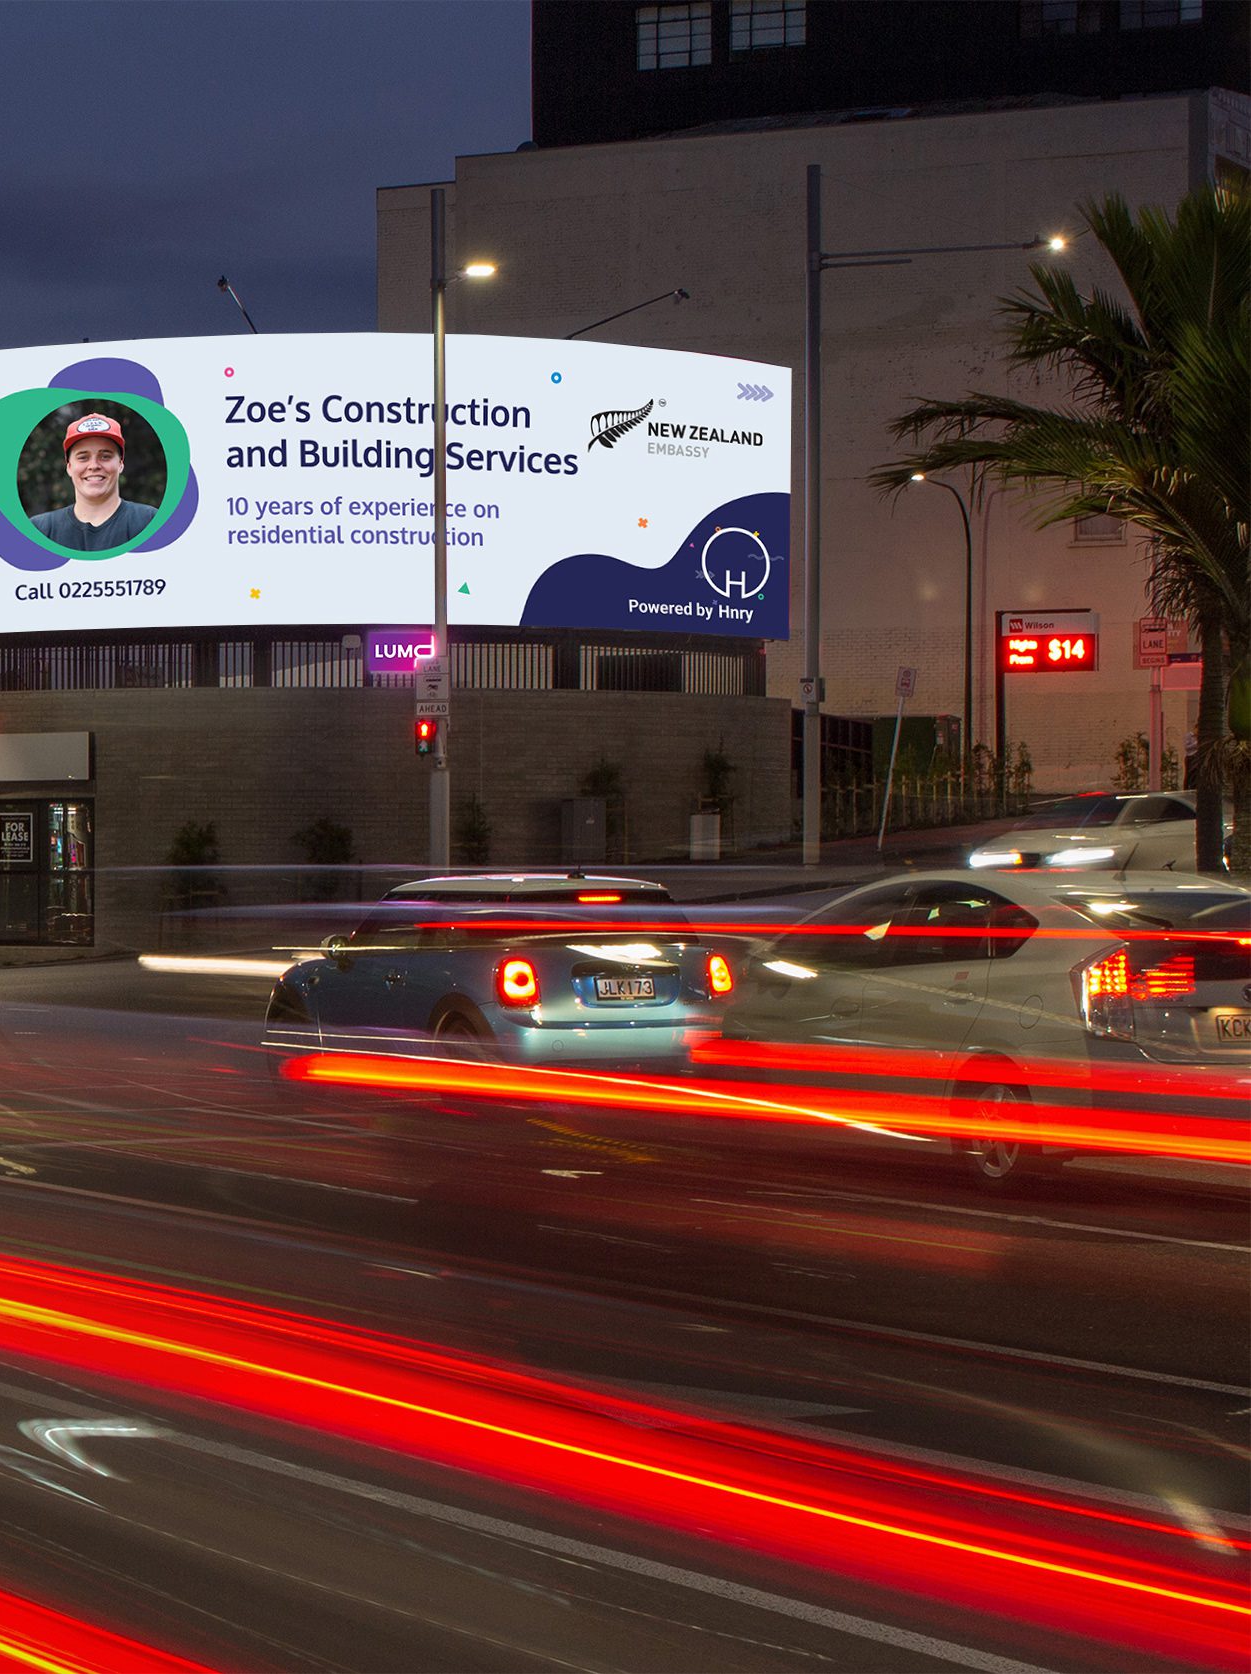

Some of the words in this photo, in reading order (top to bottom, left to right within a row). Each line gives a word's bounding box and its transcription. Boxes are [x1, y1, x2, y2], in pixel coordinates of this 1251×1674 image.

[225, 395, 311, 423] Zoe's
[648, 422, 686, 439] NEW
[689, 425, 763, 447] ZEALAND
[226, 439, 287, 468] and
[300, 439, 435, 477] Building
[446, 442, 578, 475] Services
[647, 442, 710, 458] EMBASSY
[227, 497, 248, 515] 10
[255, 500, 314, 520] years
[320, 496, 343, 515] of
[473, 503, 499, 519] on
[228, 525, 344, 544] residential
[15, 583, 54, 600] Call
[59, 579, 166, 599] 0225551789
[628, 599, 692, 616] Powered
[696, 603, 713, 621] by
[718, 605, 753, 624] Hnry
[1024, 621, 1055, 630] Wilson
[1048, 638, 1085, 661] $14
[1143, 640, 1164, 649] LANE
[419, 704, 447, 713] AHEAD
[4, 822, 24, 832] FOR
[1, 832, 29, 842] LEASE
[600, 981, 653, 996] JLK173
